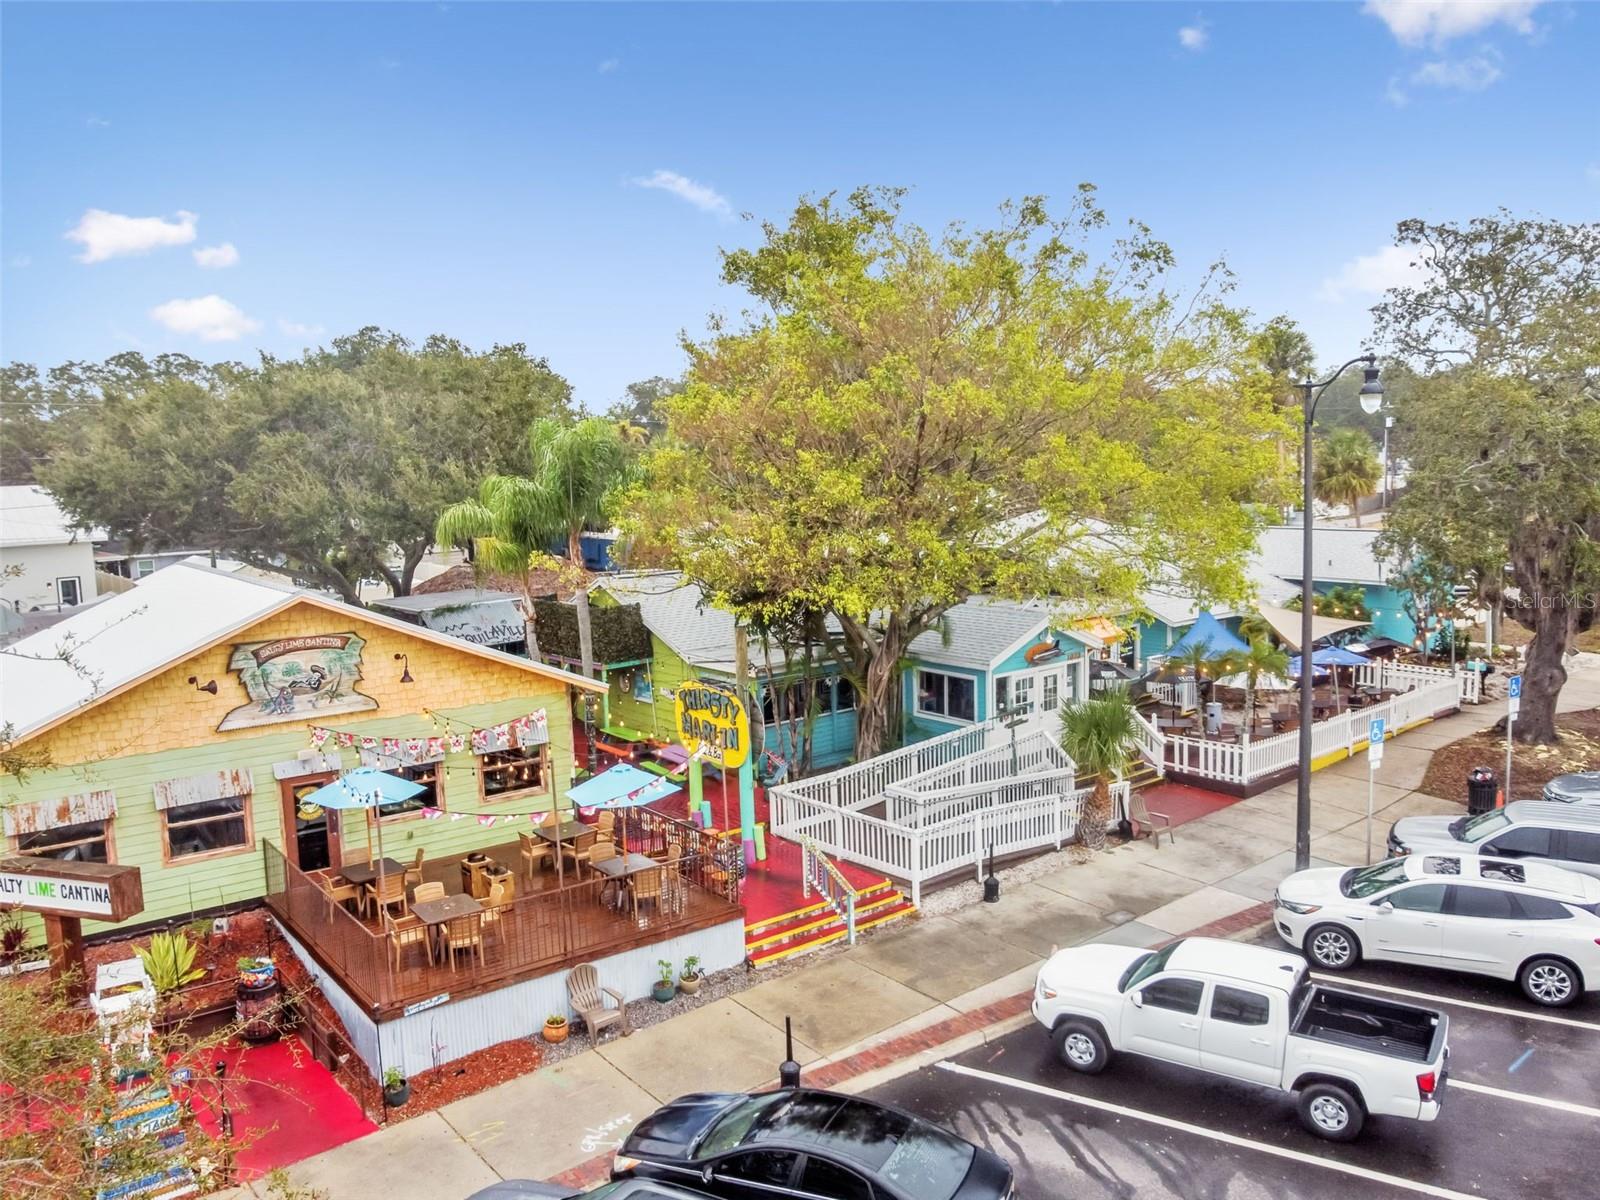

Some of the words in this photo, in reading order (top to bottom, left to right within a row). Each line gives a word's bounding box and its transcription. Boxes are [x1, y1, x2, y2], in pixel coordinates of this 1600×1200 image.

[260, 642, 284, 658] SALTY
[306, 637, 341, 648] CANTINA
[679, 688, 741, 726] THIRSTY
[681, 711, 740, 752] MARLIN
[27, 880, 57, 898] LIME
[60, 884, 111, 904] CANTINA
